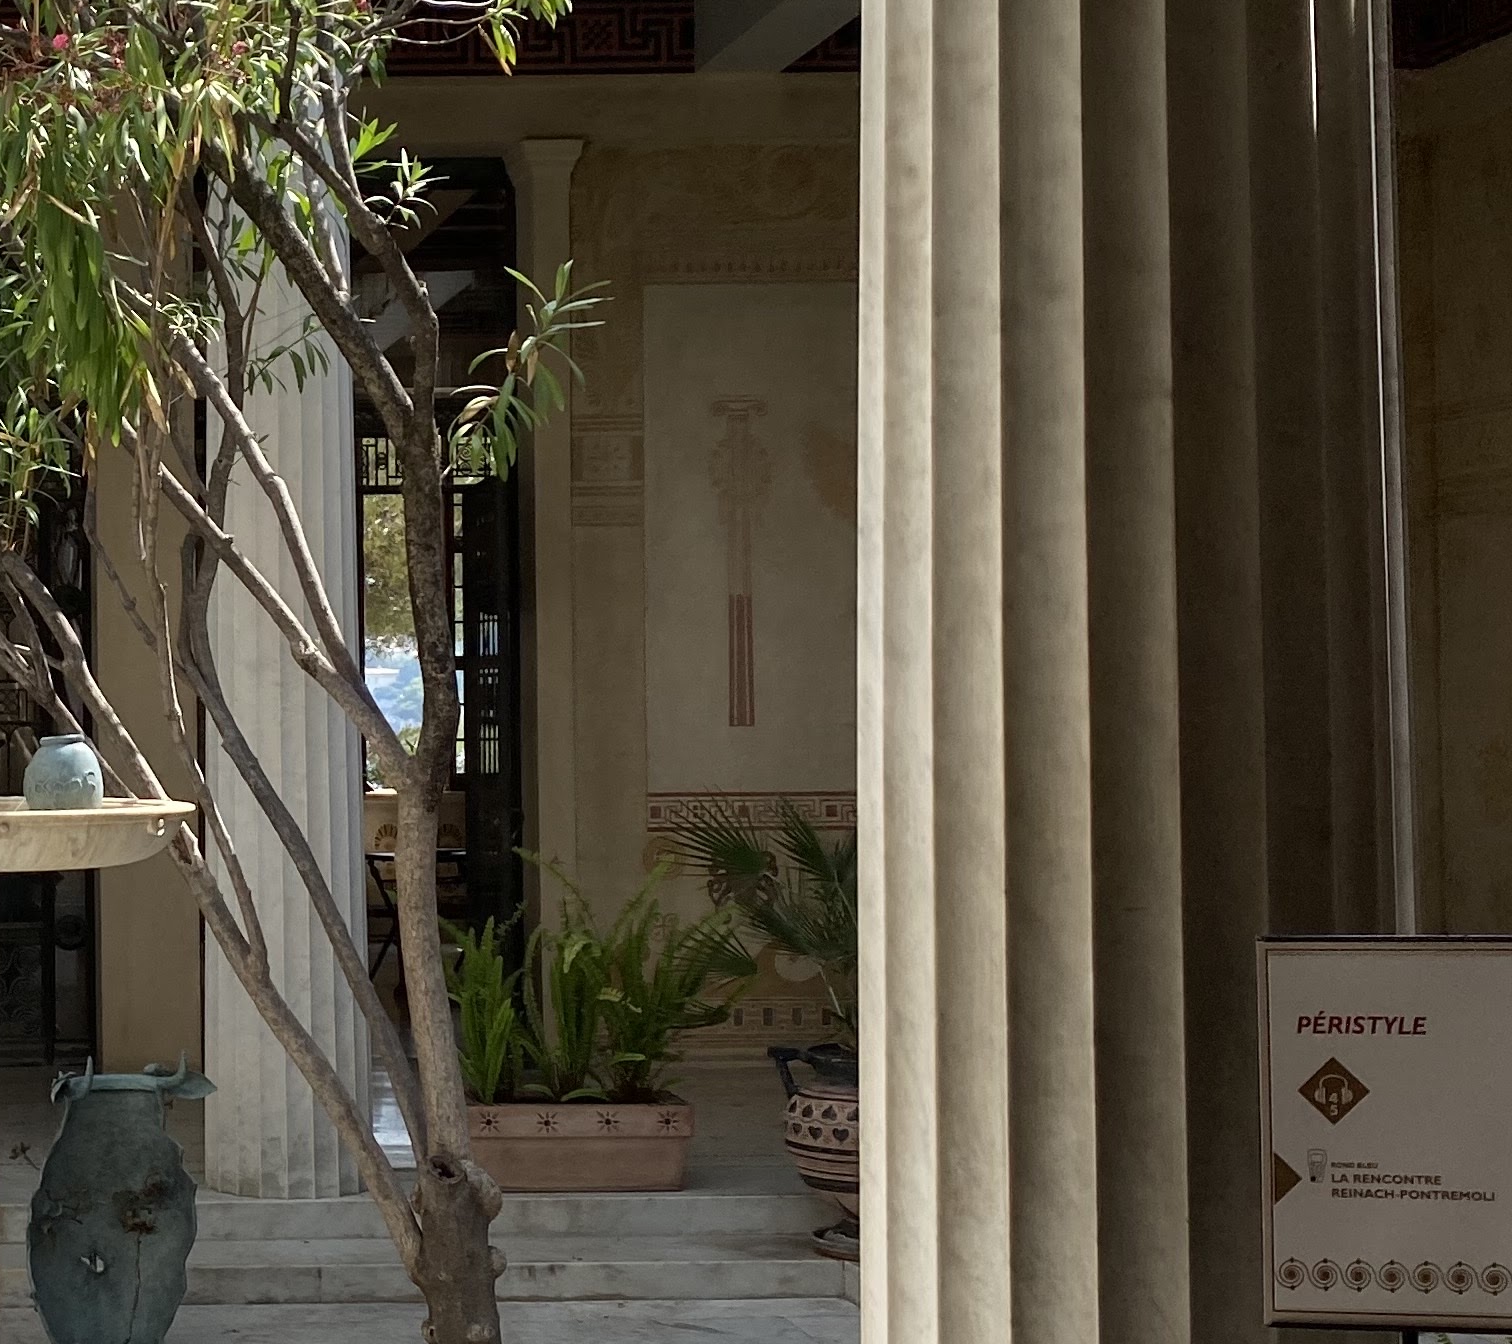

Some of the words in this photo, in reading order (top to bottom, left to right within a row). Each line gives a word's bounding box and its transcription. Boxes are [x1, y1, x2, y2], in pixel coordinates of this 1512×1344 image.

[1297, 1010, 1427, 1035] PÉRISTYLE
[1329, 1092, 1339, 1104] 4
[1329, 1104, 1339, 1116] 5
[1331, 1173, 1350, 1184] LA
[1352, 1173, 1442, 1186] RENCONTRE
[1331, 1188, 1495, 1202] REINACH-PONTREMOLI
